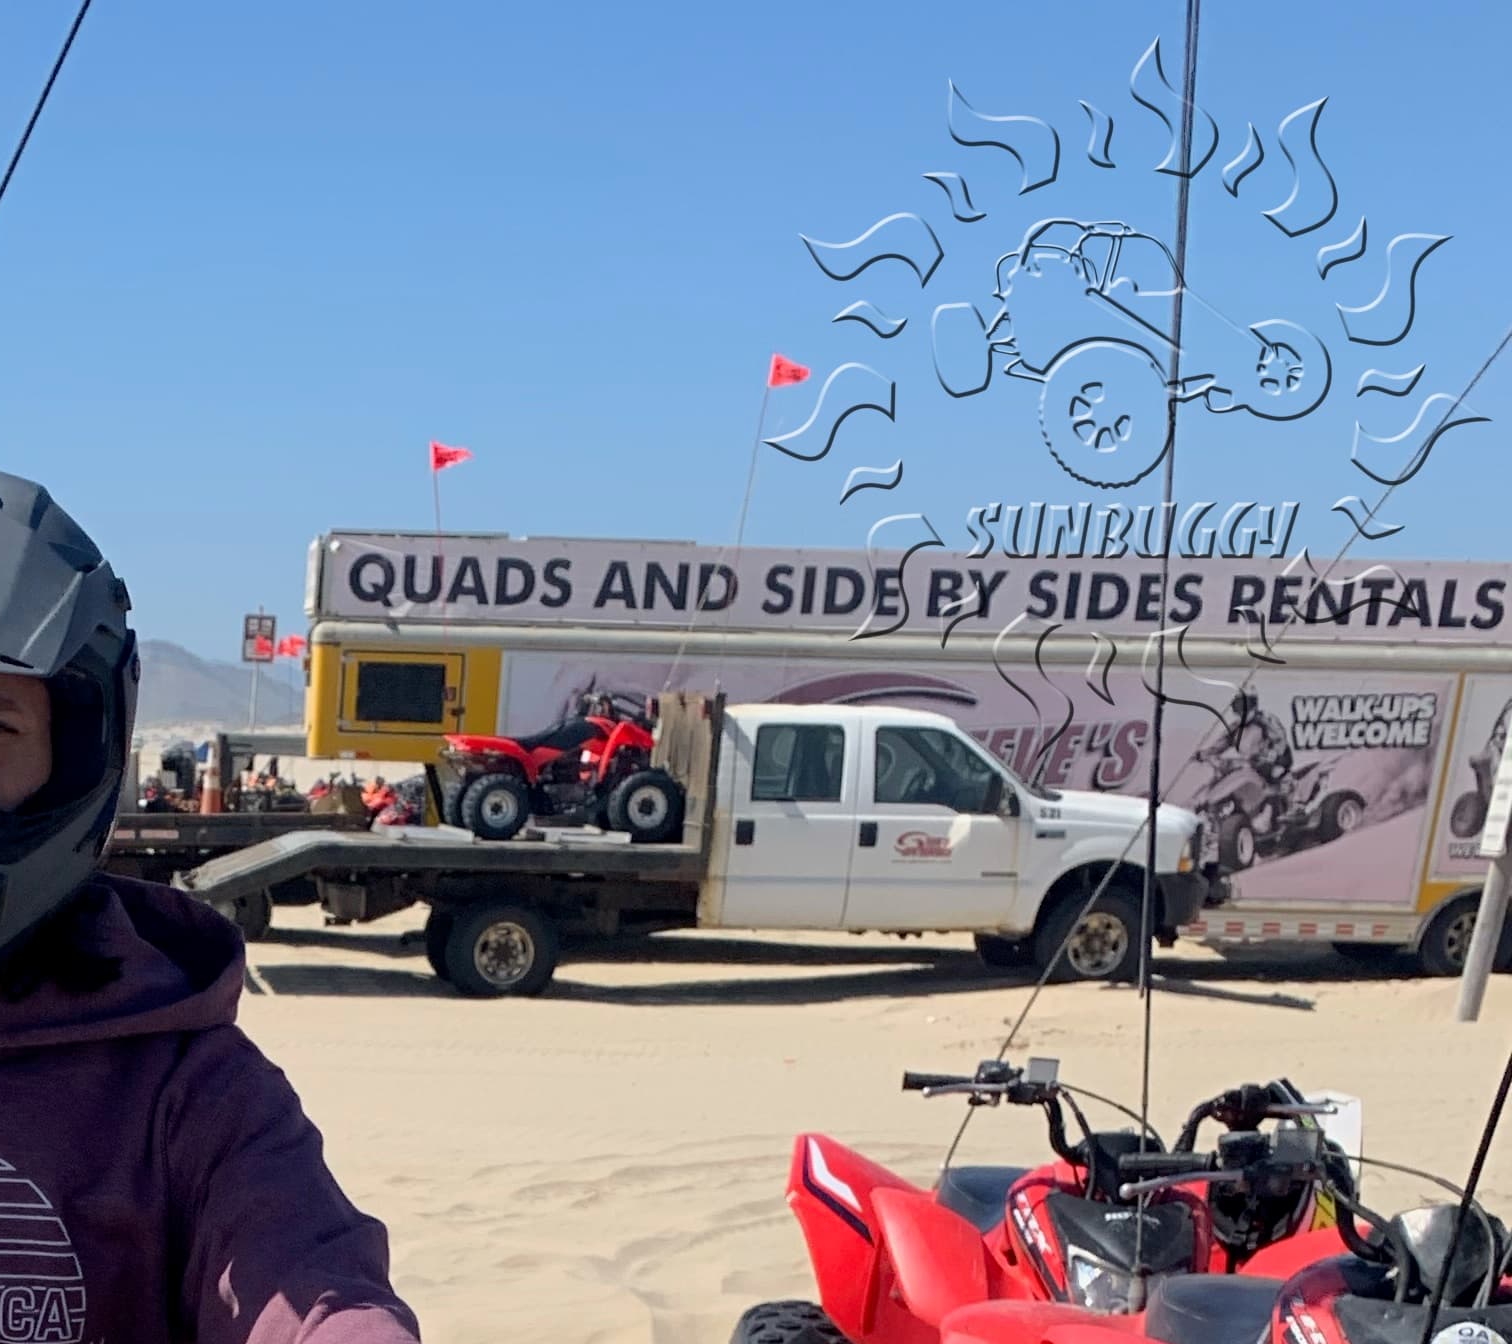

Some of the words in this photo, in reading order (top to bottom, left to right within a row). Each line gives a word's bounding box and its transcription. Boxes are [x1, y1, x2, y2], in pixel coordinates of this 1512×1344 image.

[349, 552, 574, 609] QUADS
[594, 561, 739, 611] AND
[761, 565, 902, 617] SIDE
[926, 568, 1009, 619] BY
[1026, 571, 1204, 624] SIDES
[1227, 575, 1507, 630] RENTALS
[1293, 692, 1437, 722] WALK-UPS
[1294, 719, 1431, 749] WELCOME
[0, 1286, 75, 1342] CA
